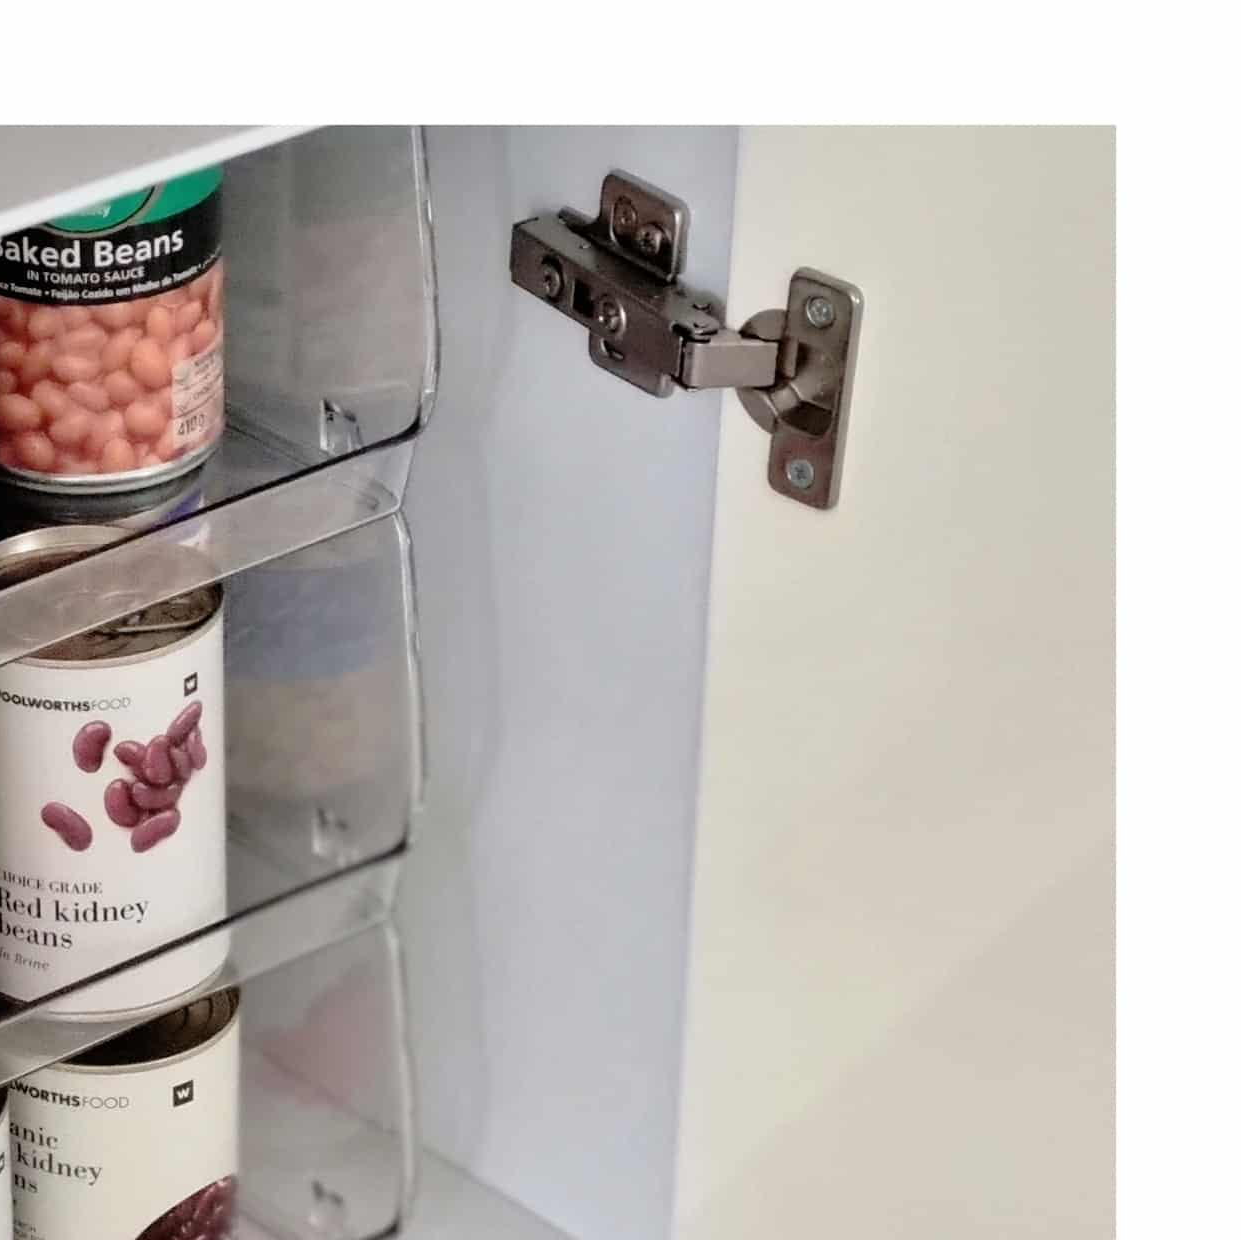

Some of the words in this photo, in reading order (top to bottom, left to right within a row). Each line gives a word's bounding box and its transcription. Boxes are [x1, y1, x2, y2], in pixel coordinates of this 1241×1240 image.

[94, 230, 183, 267] Beans
[27, 269, 39, 280] IN
[42, 271, 100, 284] TOMATO
[104, 266, 145, 282] SAUCE
[49, 881, 103, 895] GRADE
[54, 899, 149, 923] kidney
[14, 953, 50, 970] Brine
[10, 1080, 129, 1109] LWORTHSFOOD
[9, 1122, 58, 1150] anic
[17, 1143, 102, 1186] kidney
